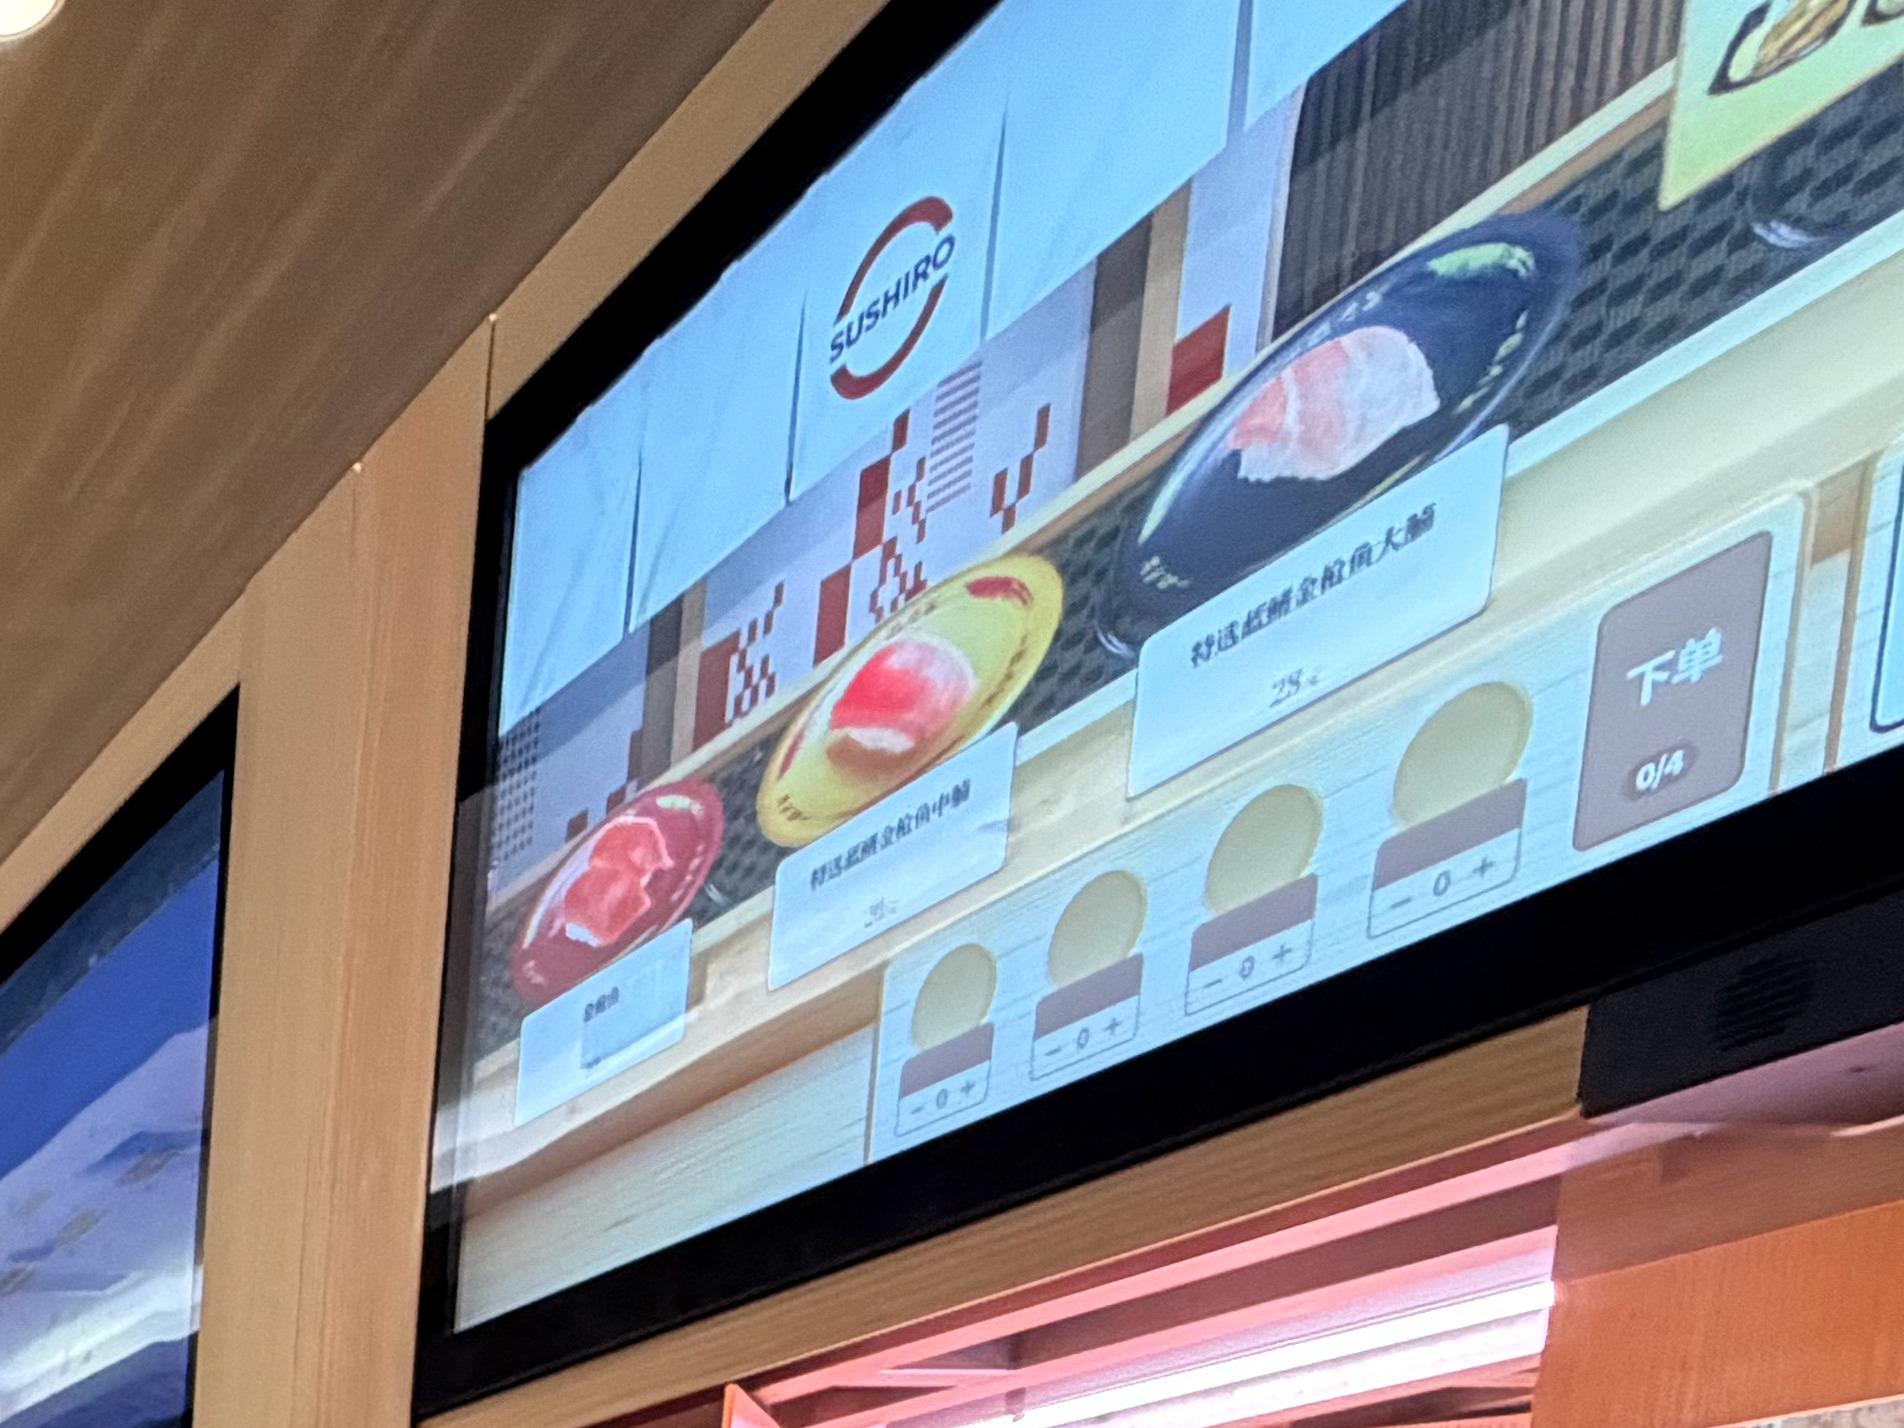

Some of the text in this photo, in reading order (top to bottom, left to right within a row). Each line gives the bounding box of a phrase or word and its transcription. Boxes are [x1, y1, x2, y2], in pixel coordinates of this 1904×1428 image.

[829, 233, 956, 364] SUSHIRO
[1626, 626, 1724, 707] 下单
[1635, 749, 1684, 791] 0/4
[1432, 870, 1453, 897] 0
[1239, 955, 1256, 981] 0
[1076, 1027, 1090, 1050] 0
[935, 1088, 949, 1110] 0
